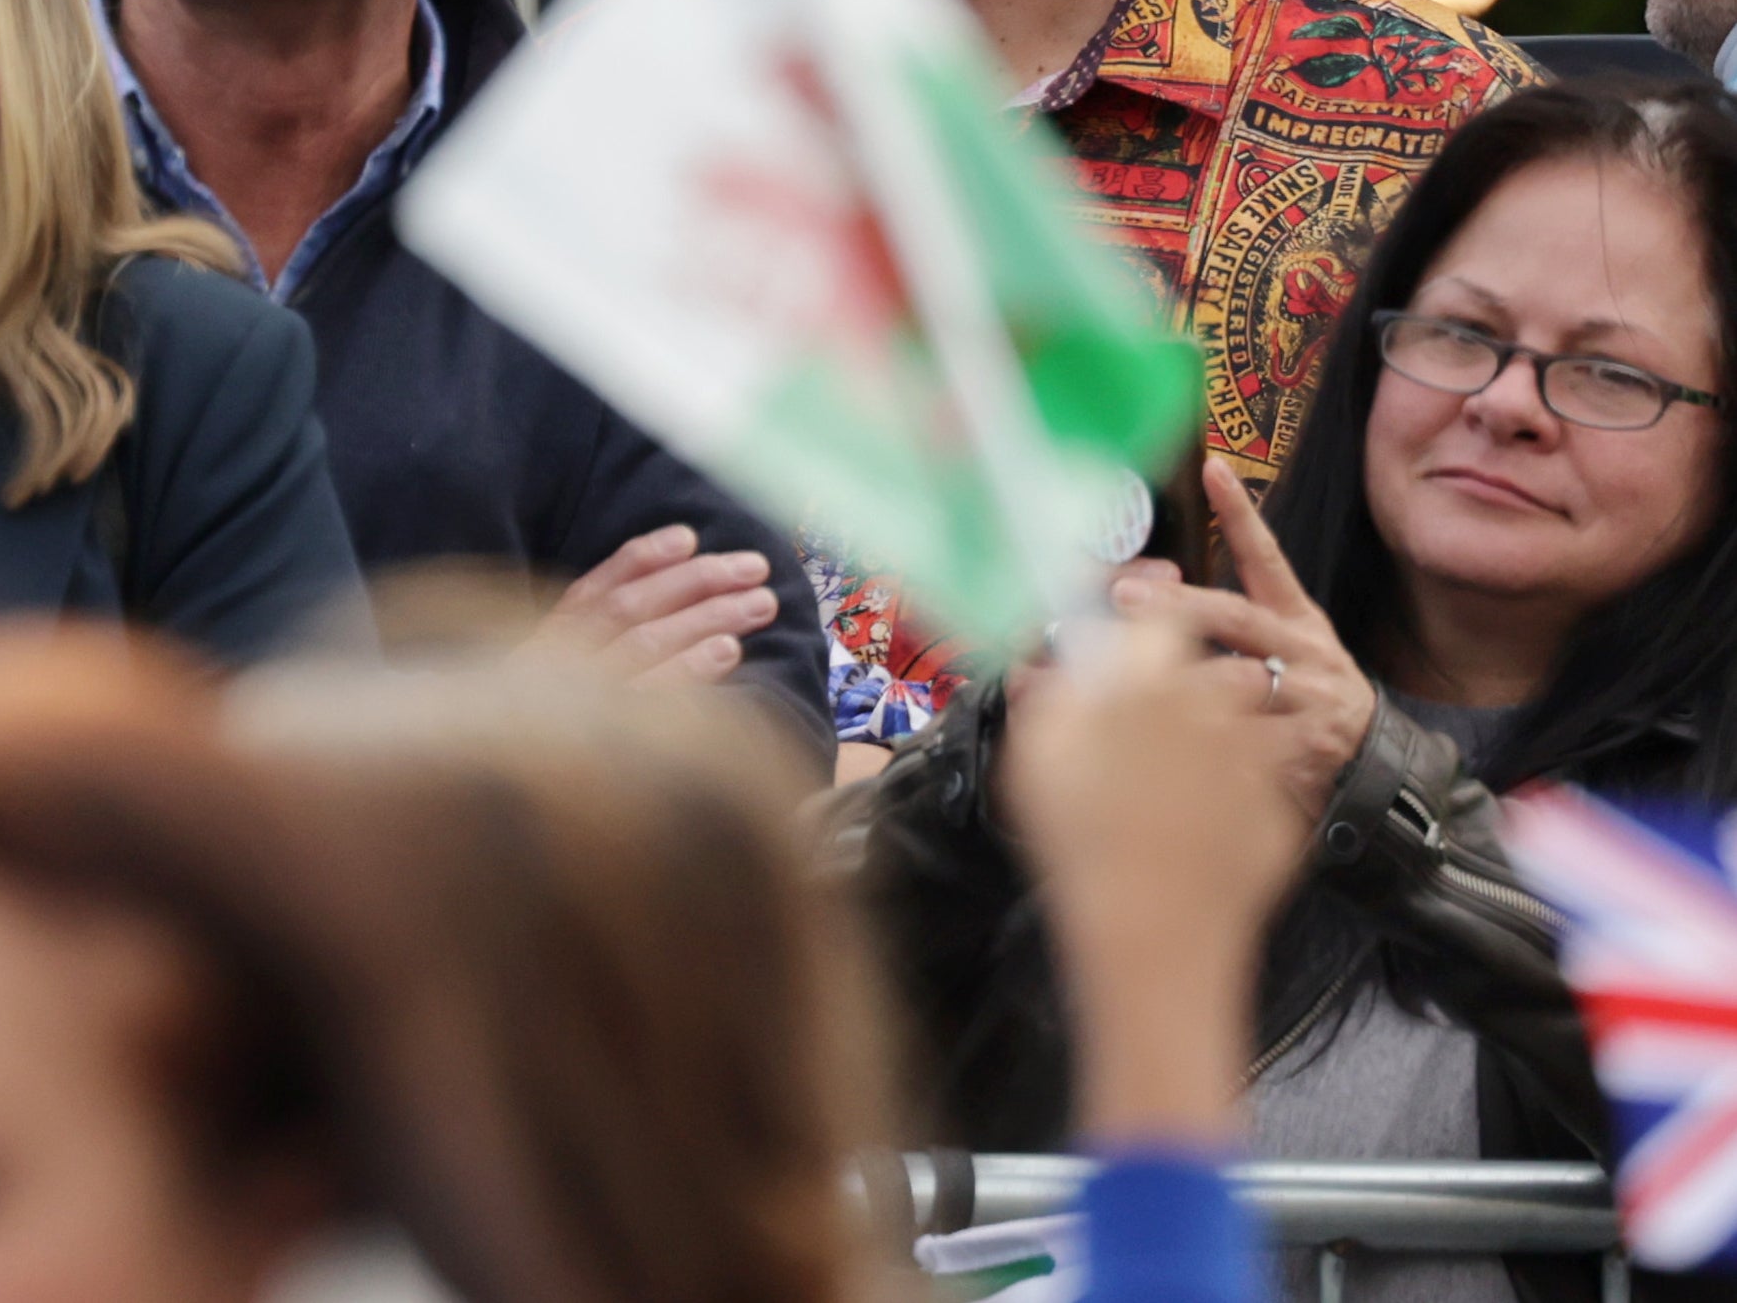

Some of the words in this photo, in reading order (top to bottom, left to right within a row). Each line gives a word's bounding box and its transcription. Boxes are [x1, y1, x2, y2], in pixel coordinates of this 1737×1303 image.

[1240, 163, 1318, 224] SNAKE
[1333, 203, 1351, 218] IN
[1337, 164, 1360, 199] MADE
[1229, 225, 1282, 363] REGISTERED
[1197, 322, 1253, 442] MATCHES
